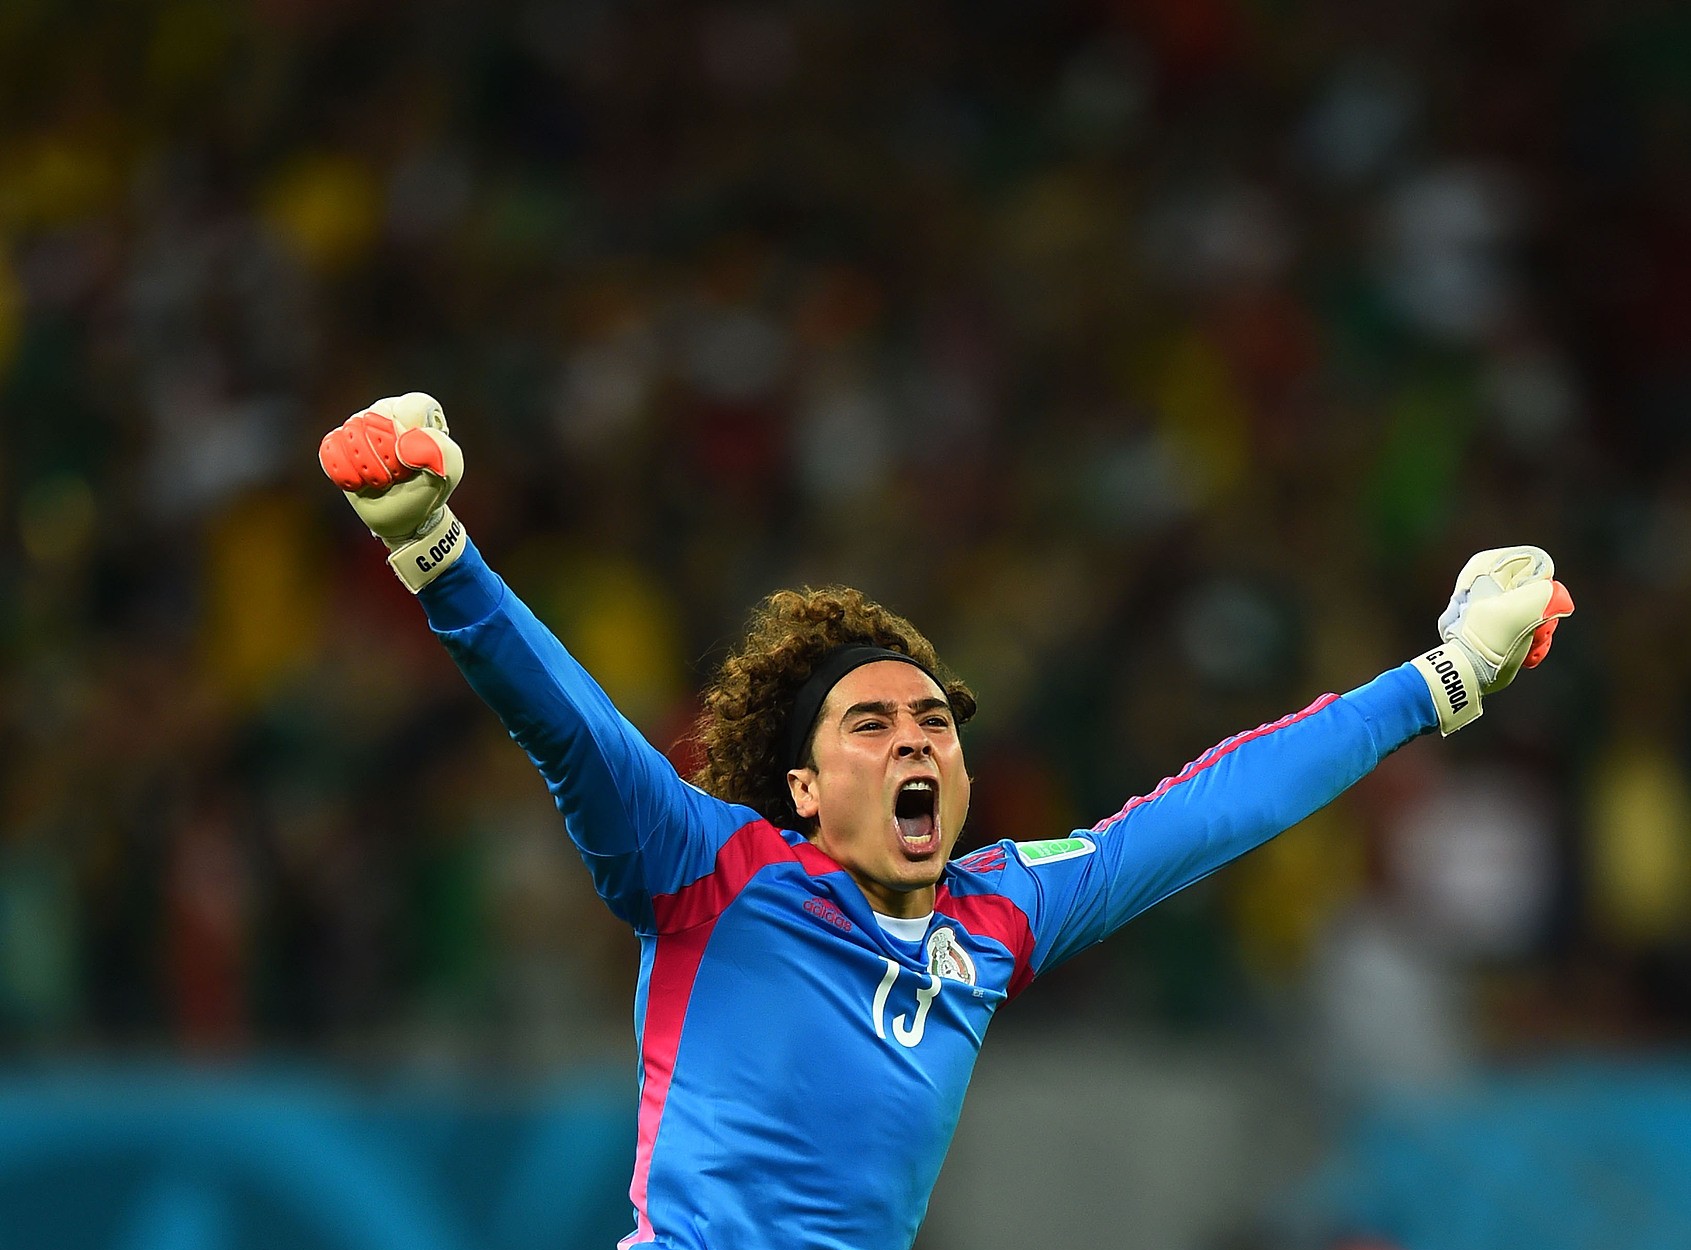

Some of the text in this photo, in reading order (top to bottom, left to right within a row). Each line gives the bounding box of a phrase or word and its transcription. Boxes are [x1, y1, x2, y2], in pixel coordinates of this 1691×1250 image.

[416, 521, 461, 573] G.OCHO
[1426, 650, 1469, 715] G.OCHOA
[803, 899, 852, 932] adidas
[872, 955, 942, 1048] 13
